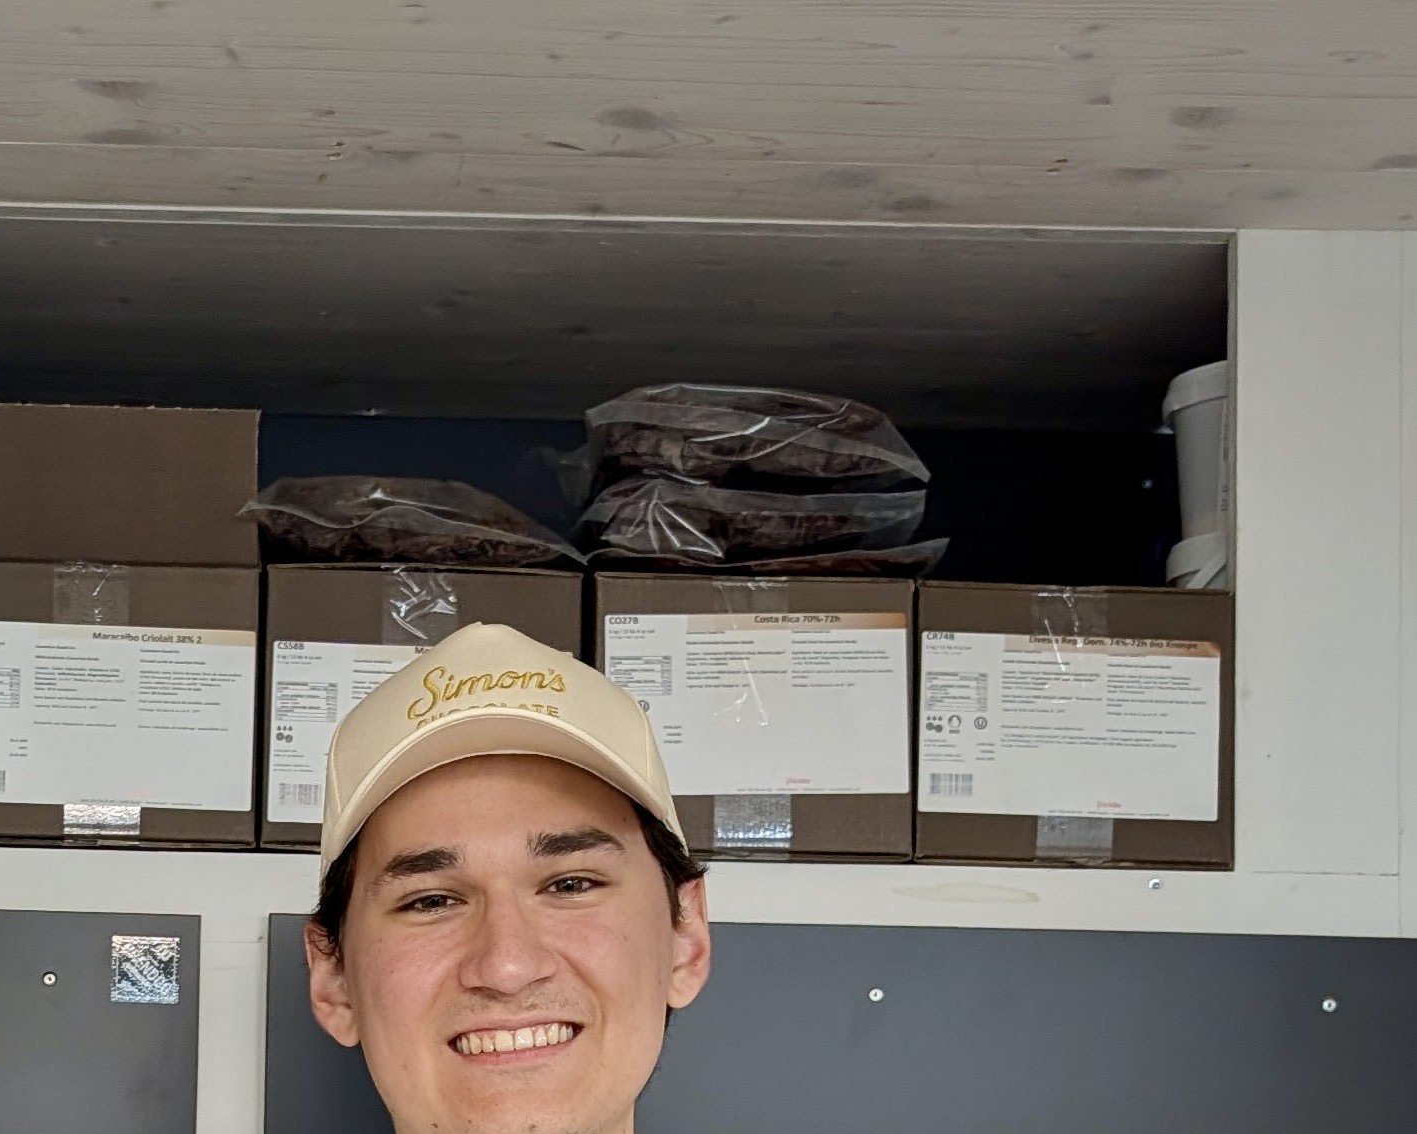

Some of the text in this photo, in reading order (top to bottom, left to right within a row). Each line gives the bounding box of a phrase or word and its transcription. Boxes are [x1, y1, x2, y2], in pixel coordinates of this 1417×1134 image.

[754, 615, 779, 623] Costa
[781, 615, 800, 623] Rica
[141, 634, 174, 643] Criolait
[407, 665, 567, 721] Simon's
